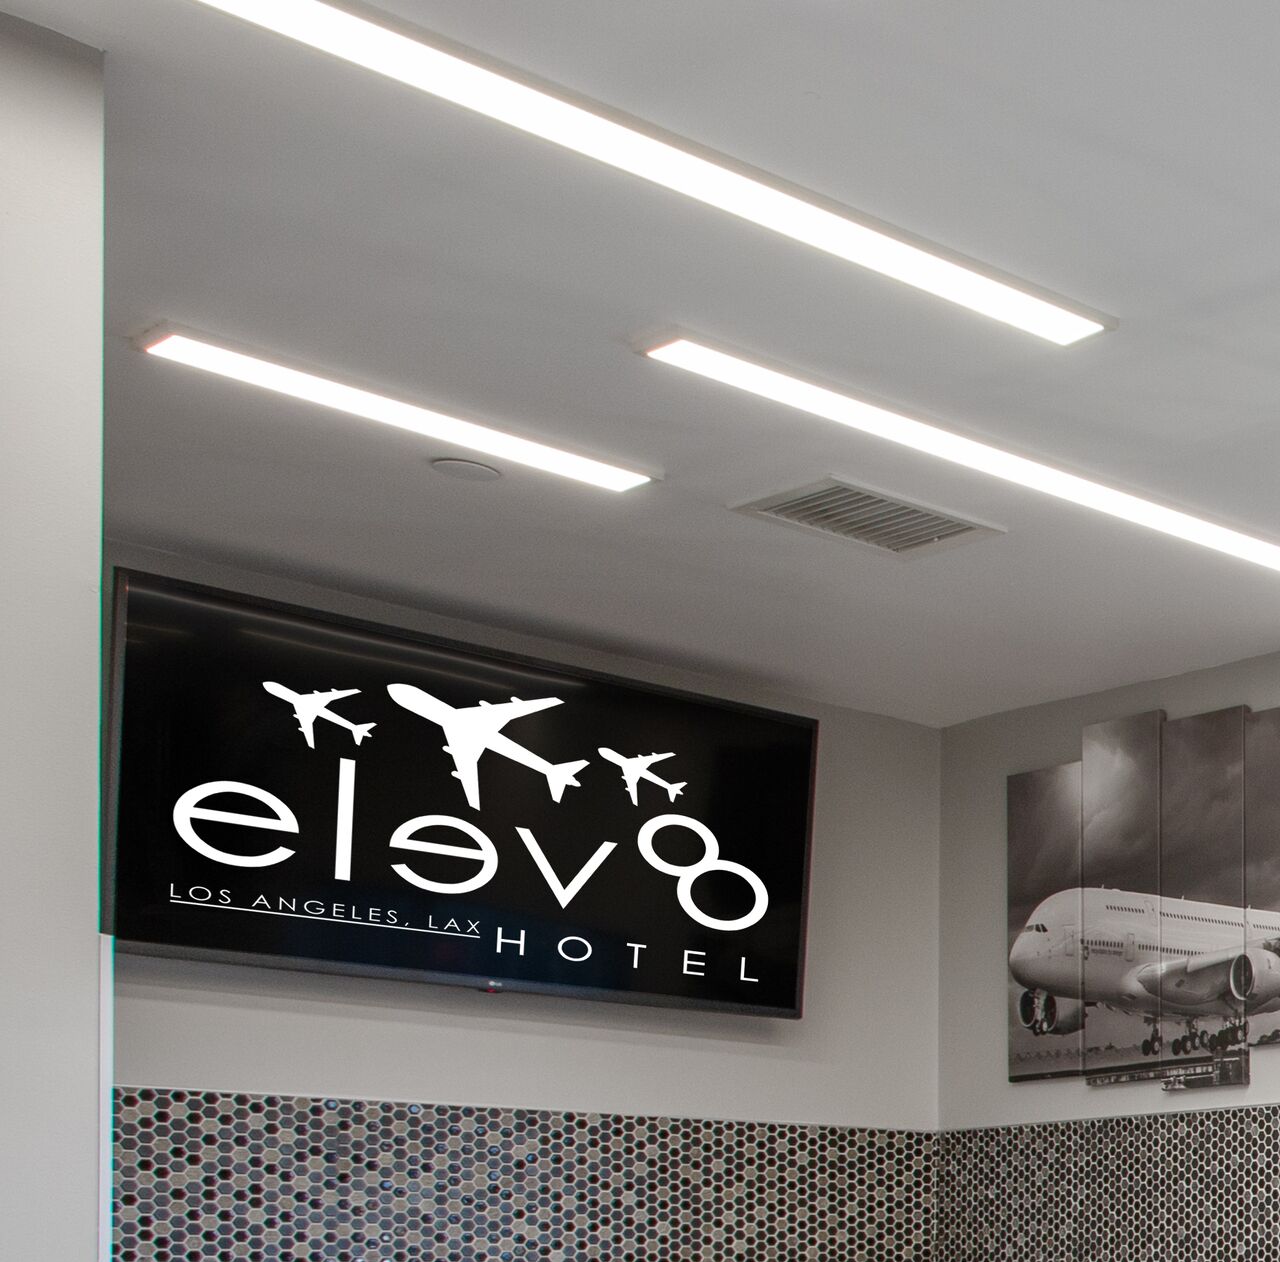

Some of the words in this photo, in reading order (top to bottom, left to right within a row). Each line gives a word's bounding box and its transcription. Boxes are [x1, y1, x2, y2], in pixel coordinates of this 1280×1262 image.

[170, 884, 231, 904] LOS
[252, 895, 411, 930] ANGELES,
[429, 915, 481, 935] LAX
[496, 927, 759, 983] HOTEL
